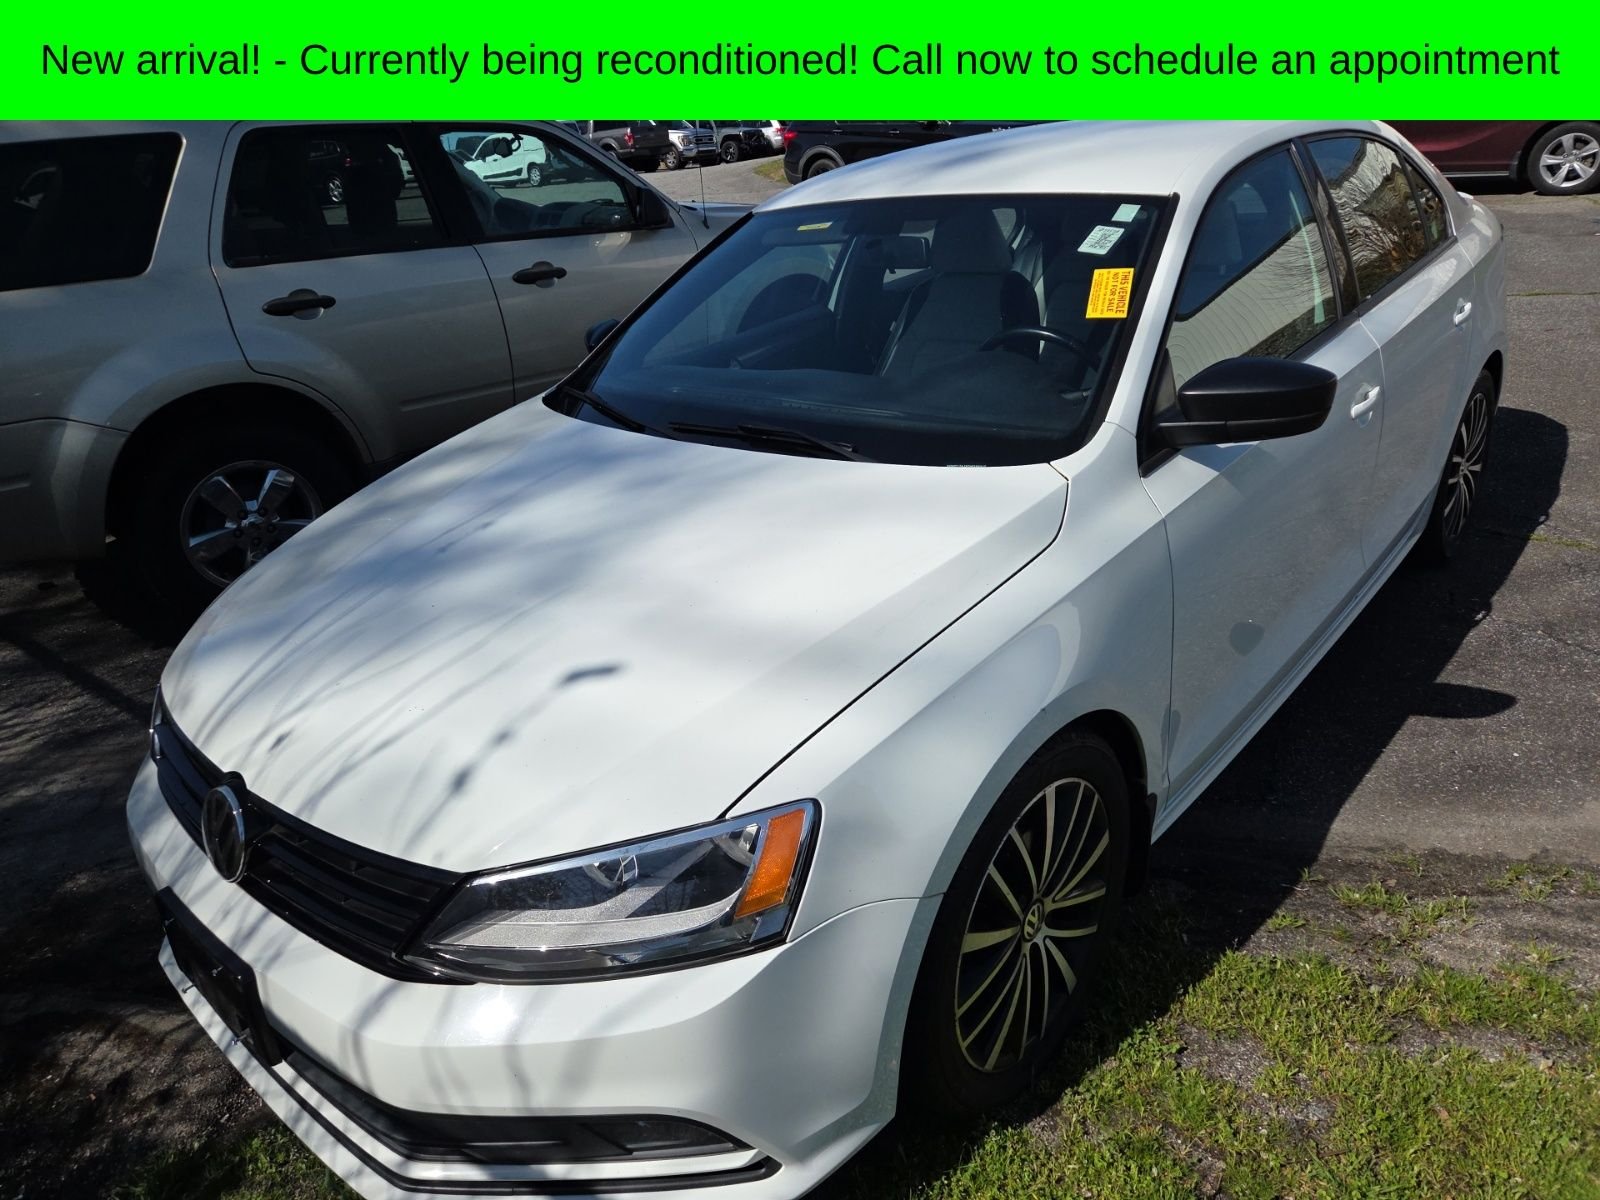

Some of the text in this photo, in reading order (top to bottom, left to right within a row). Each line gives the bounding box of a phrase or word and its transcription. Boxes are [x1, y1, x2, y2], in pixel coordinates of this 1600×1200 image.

[1106, 272, 1120, 313] NOT FOR SALE
[1115, 271, 1130, 314] THIS VEHICLE
